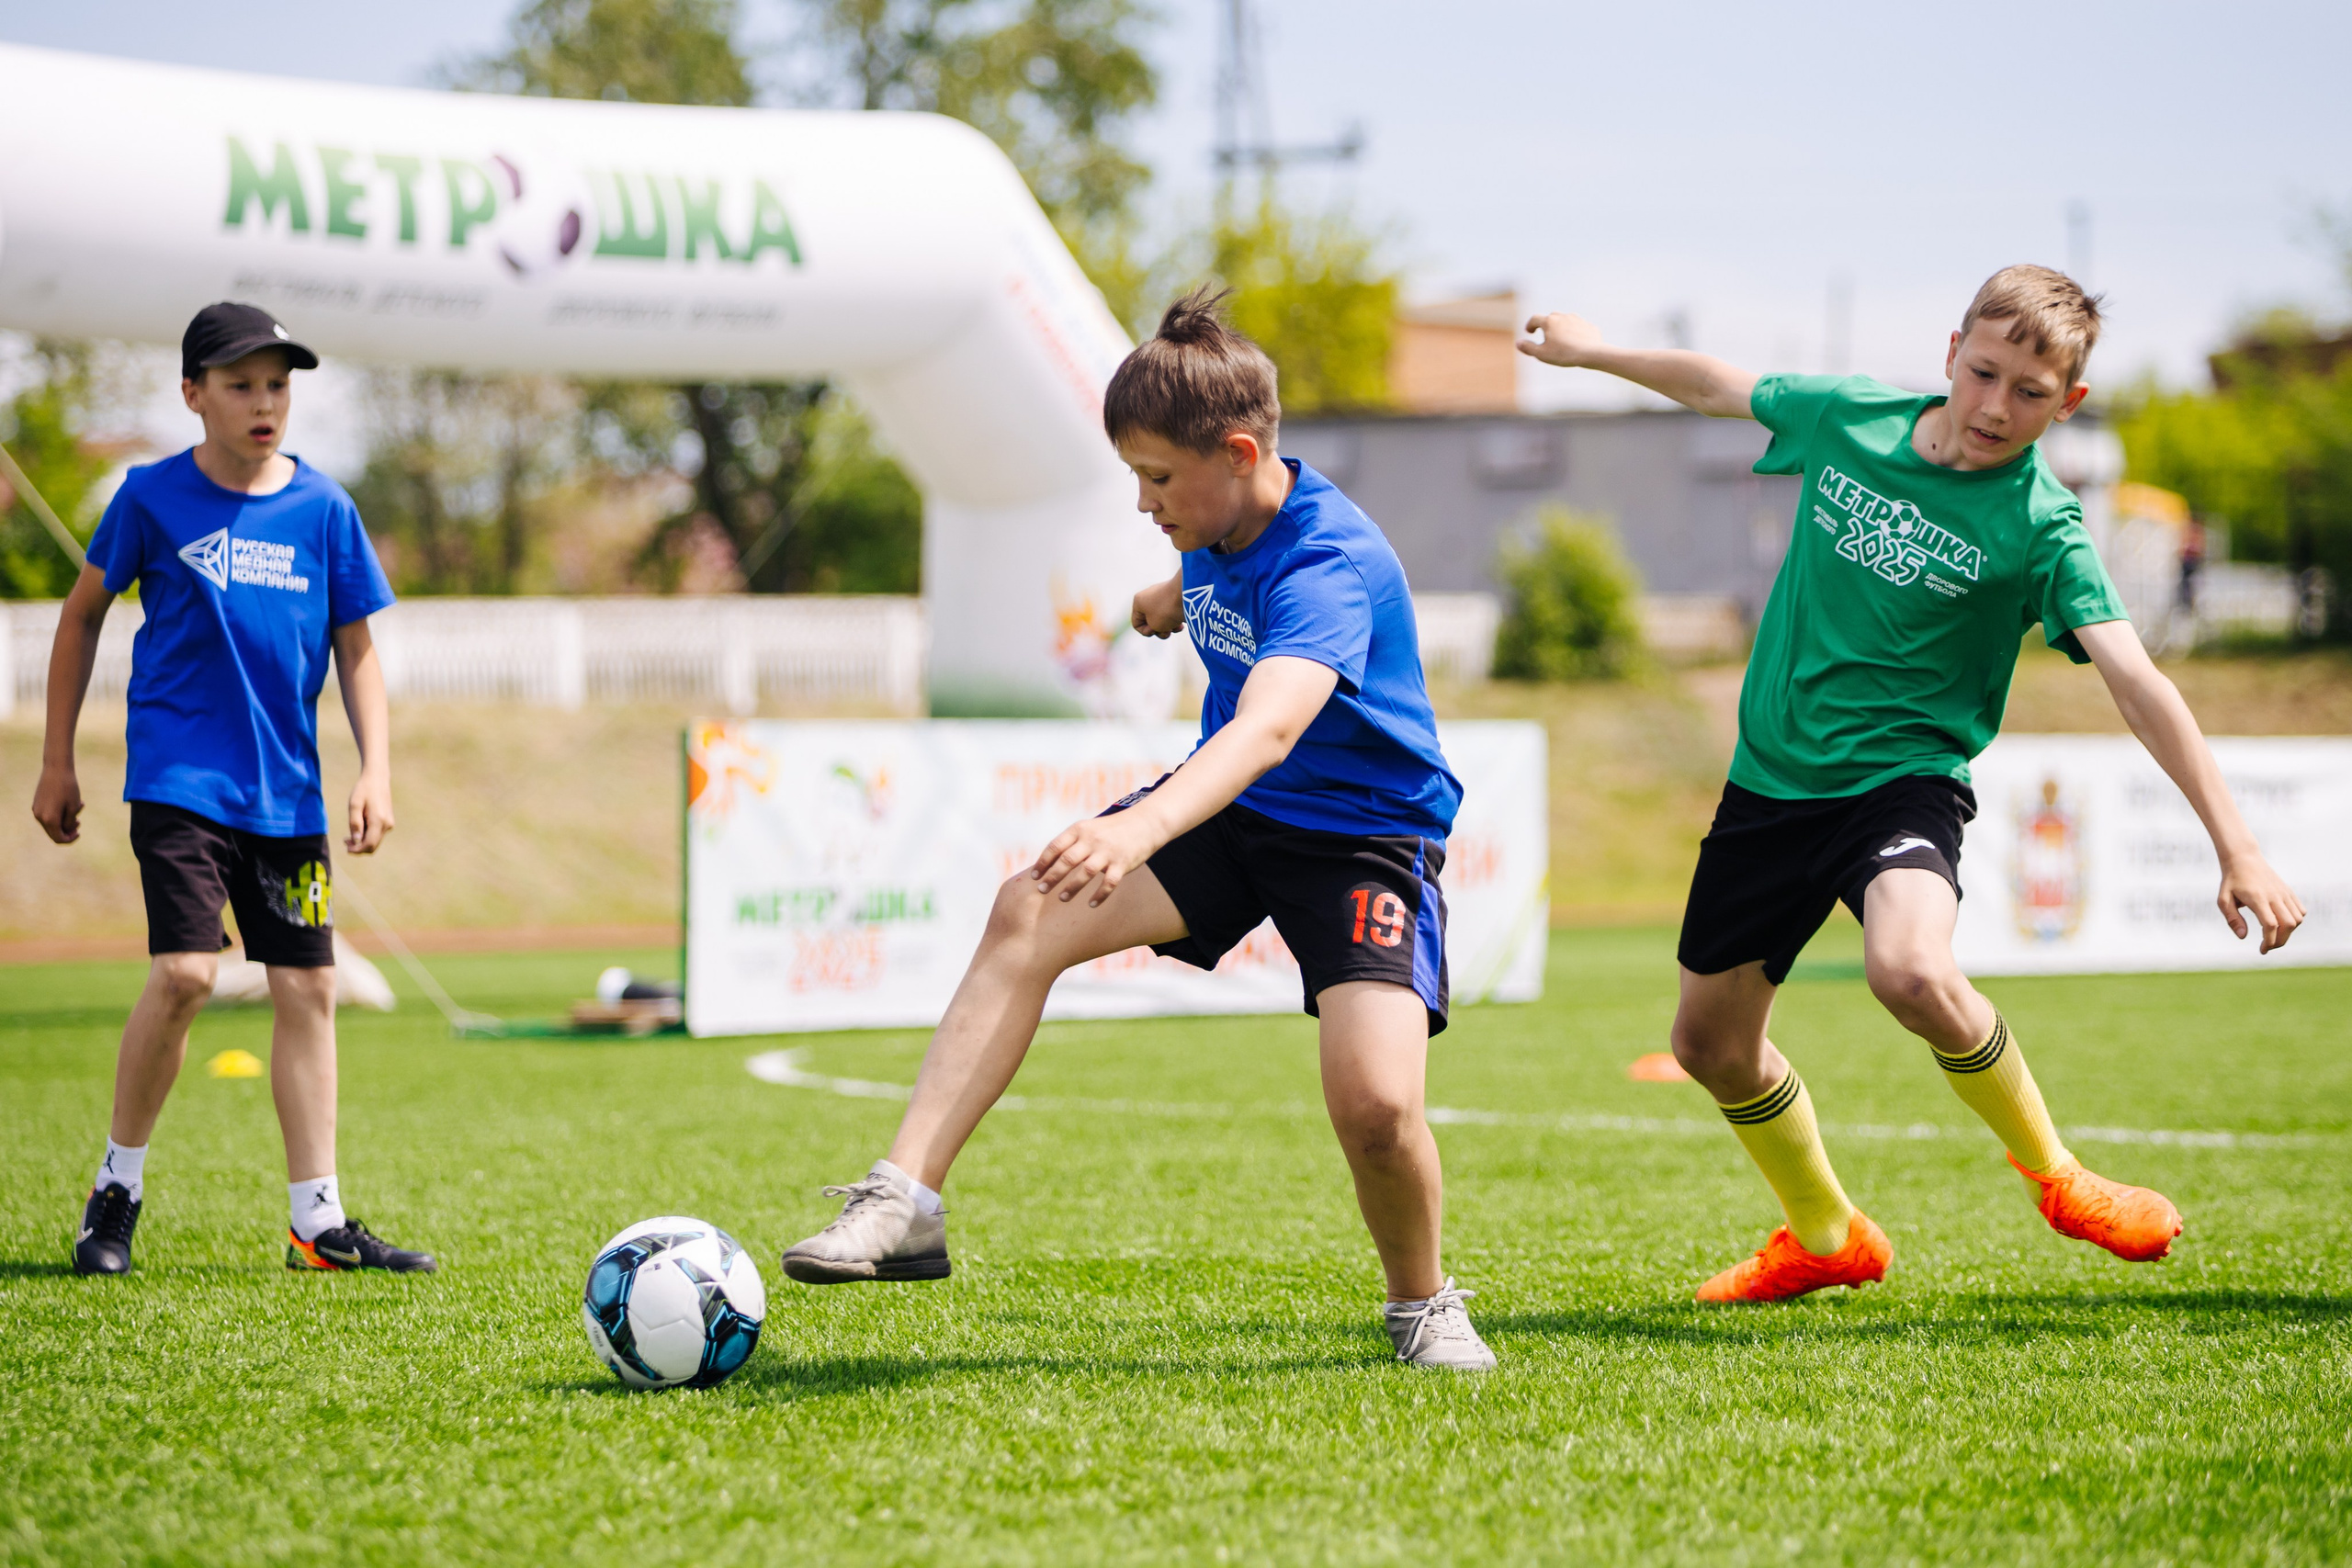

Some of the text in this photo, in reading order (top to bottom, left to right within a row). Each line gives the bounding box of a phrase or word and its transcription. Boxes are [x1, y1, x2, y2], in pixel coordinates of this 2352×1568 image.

[232, 537, 295, 562] РУССКАЯ
[232, 553, 291, 574] МЕДНАЯ
[1835, 517, 1927, 586] 2025
[232, 567, 310, 593] КОМПАНИЯ
[1924, 581, 1957, 598] ФУТБОЛА
[1925, 572, 1968, 594] ДВОРОВОГО
[1208, 599, 1254, 639] РУССКАЯ
[1208, 617, 1256, 654] МЕДНАЯ
[1208, 633, 1255, 668] КОМПАН
[1351, 889, 1406, 947] 19
